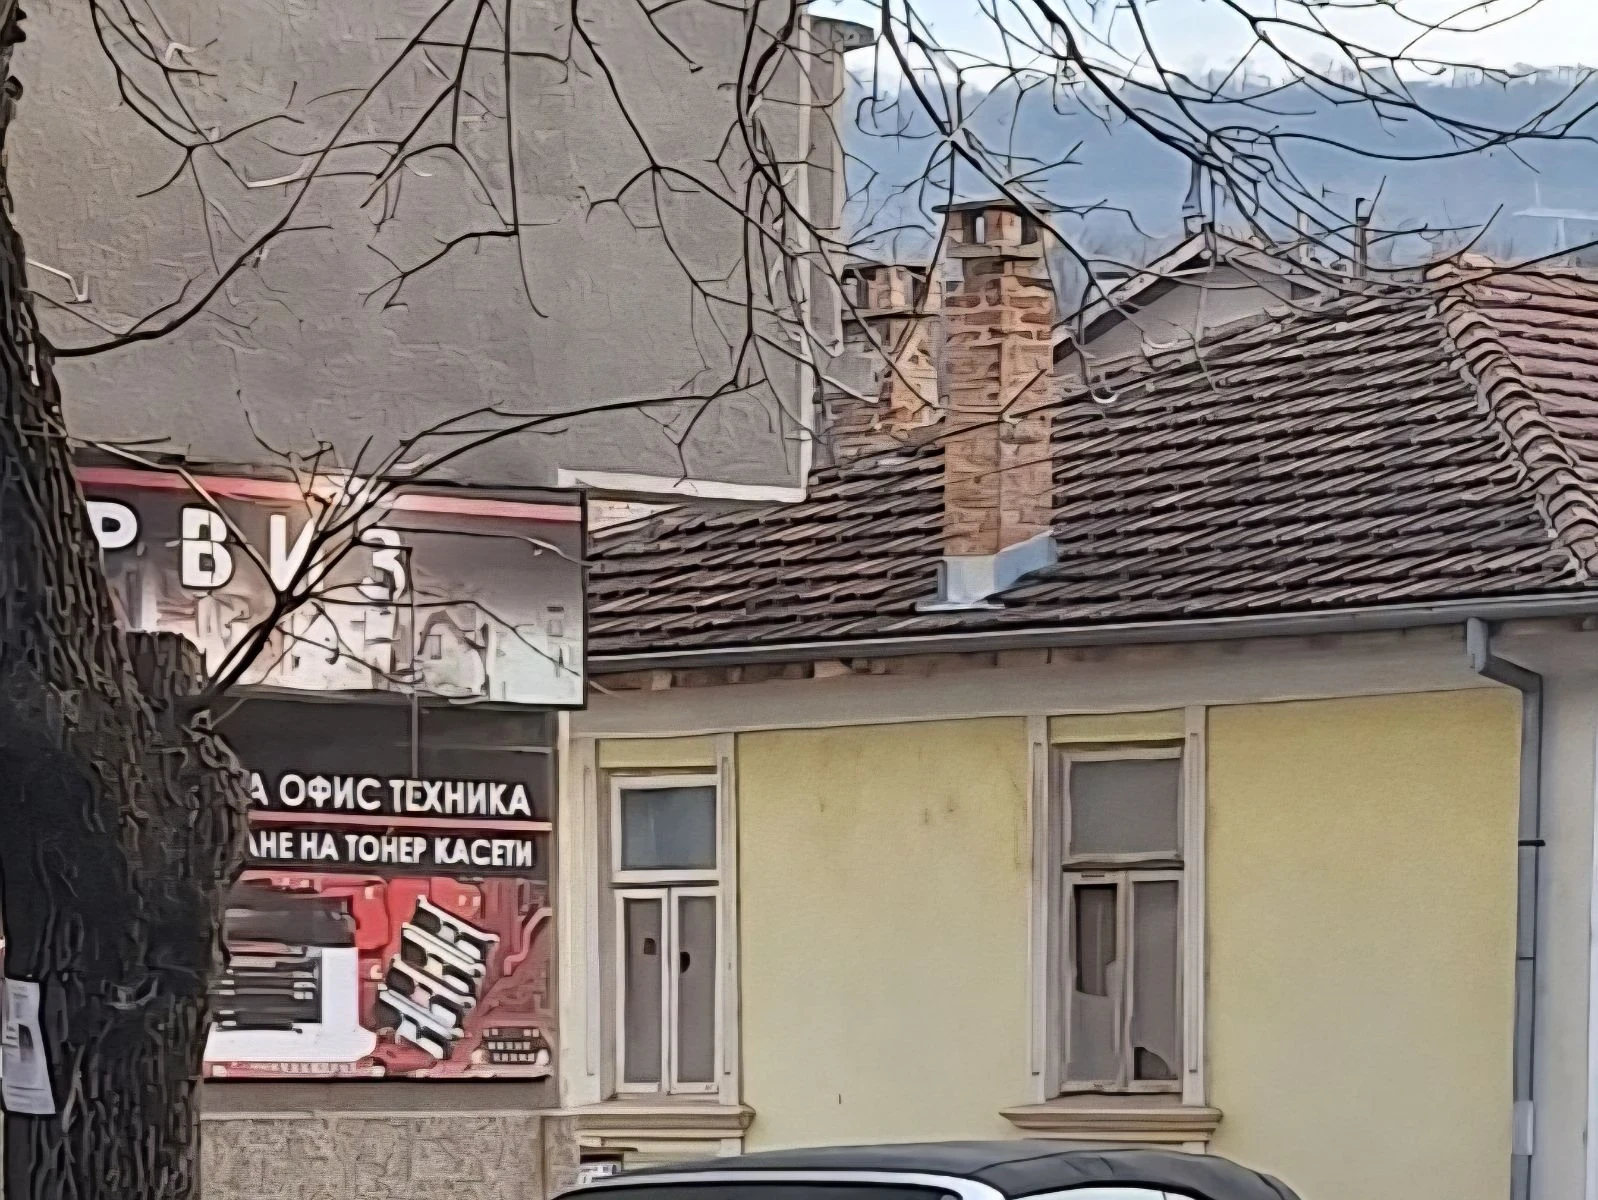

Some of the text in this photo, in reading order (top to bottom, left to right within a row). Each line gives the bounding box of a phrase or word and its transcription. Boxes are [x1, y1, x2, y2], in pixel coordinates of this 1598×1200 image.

[280, 774, 382, 811] ОФИС
[389, 779, 532, 817] ТЕХНИКА
[301, 832, 339, 861] НА
[345, 834, 427, 864] ТОНЕР
[434, 837, 532, 867] КАСЕТИ
